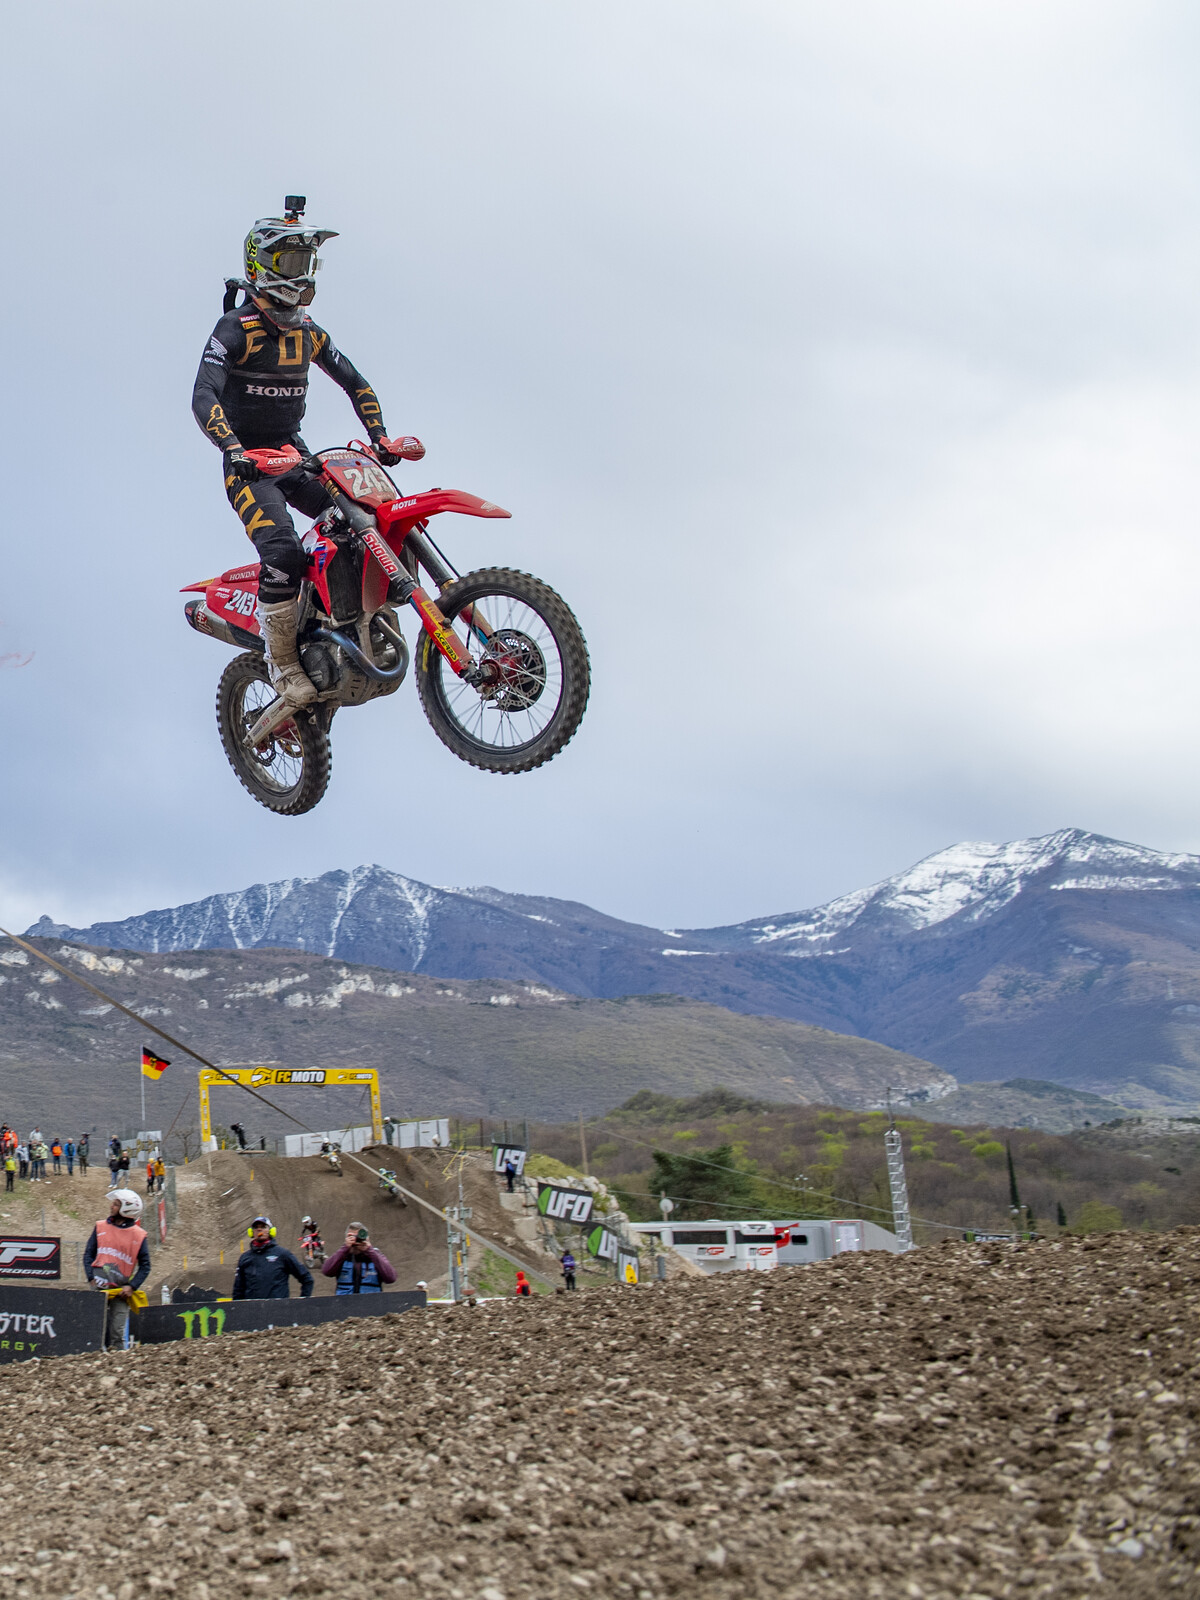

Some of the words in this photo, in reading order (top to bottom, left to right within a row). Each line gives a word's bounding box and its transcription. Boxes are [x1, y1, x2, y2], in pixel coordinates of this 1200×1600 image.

[245, 384, 307, 397] HOND
[391, 498, 417, 511] MOTUL
[361, 532, 399, 574] SHOWA
[228, 570, 256, 581] HONDA
[223, 588, 257, 617] 243
[546, 1190, 593, 1222] UFO
